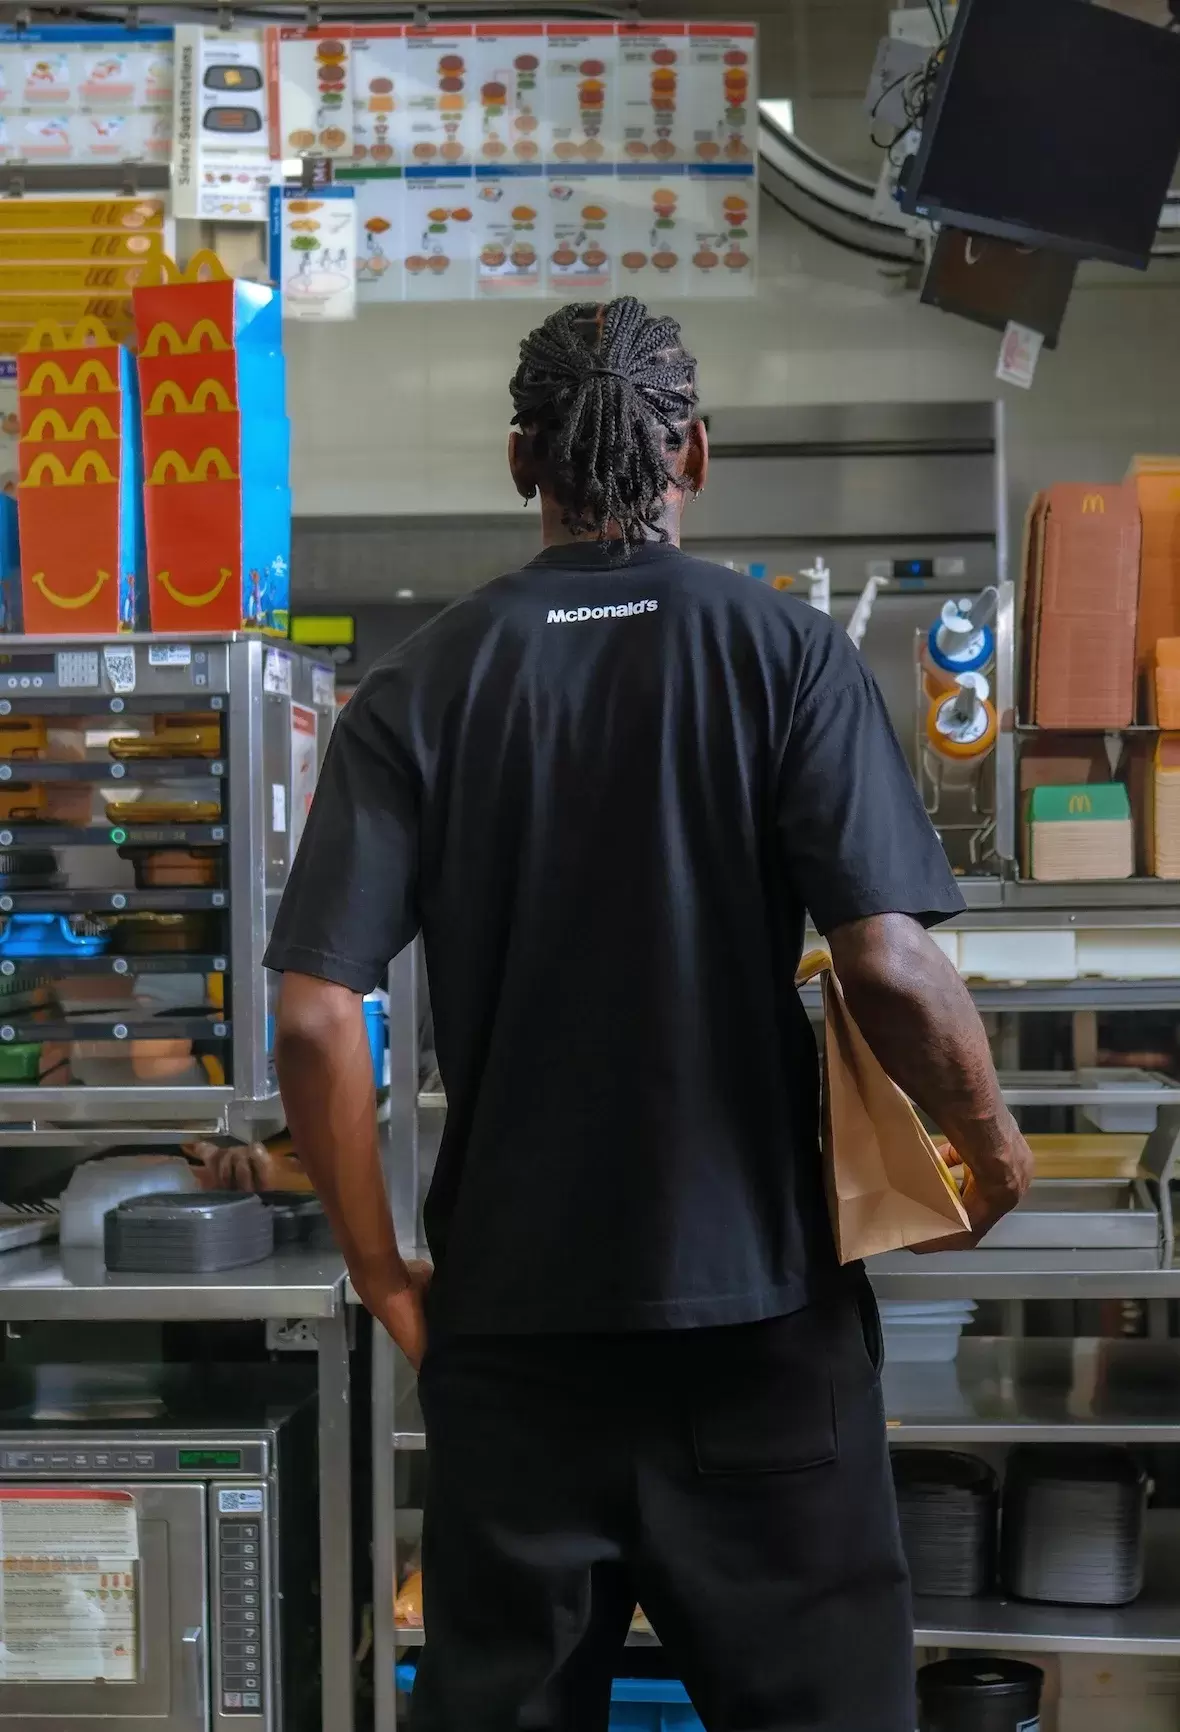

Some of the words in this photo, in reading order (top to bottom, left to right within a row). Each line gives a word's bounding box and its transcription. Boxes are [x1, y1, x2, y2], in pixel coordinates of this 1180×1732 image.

[546, 598, 659, 624] McDonald's
[244, 1528, 253, 1537] 1
[244, 1544, 254, 1554] 2
[244, 1561, 254, 1570] 3
[244, 1578, 254, 1587] 4
[244, 1595, 255, 1604] 5
[245, 1612, 255, 1620] 6
[245, 1628, 256, 1638] 7
[245, 1645, 256, 1654] 8
[246, 1662, 256, 1671] 9
